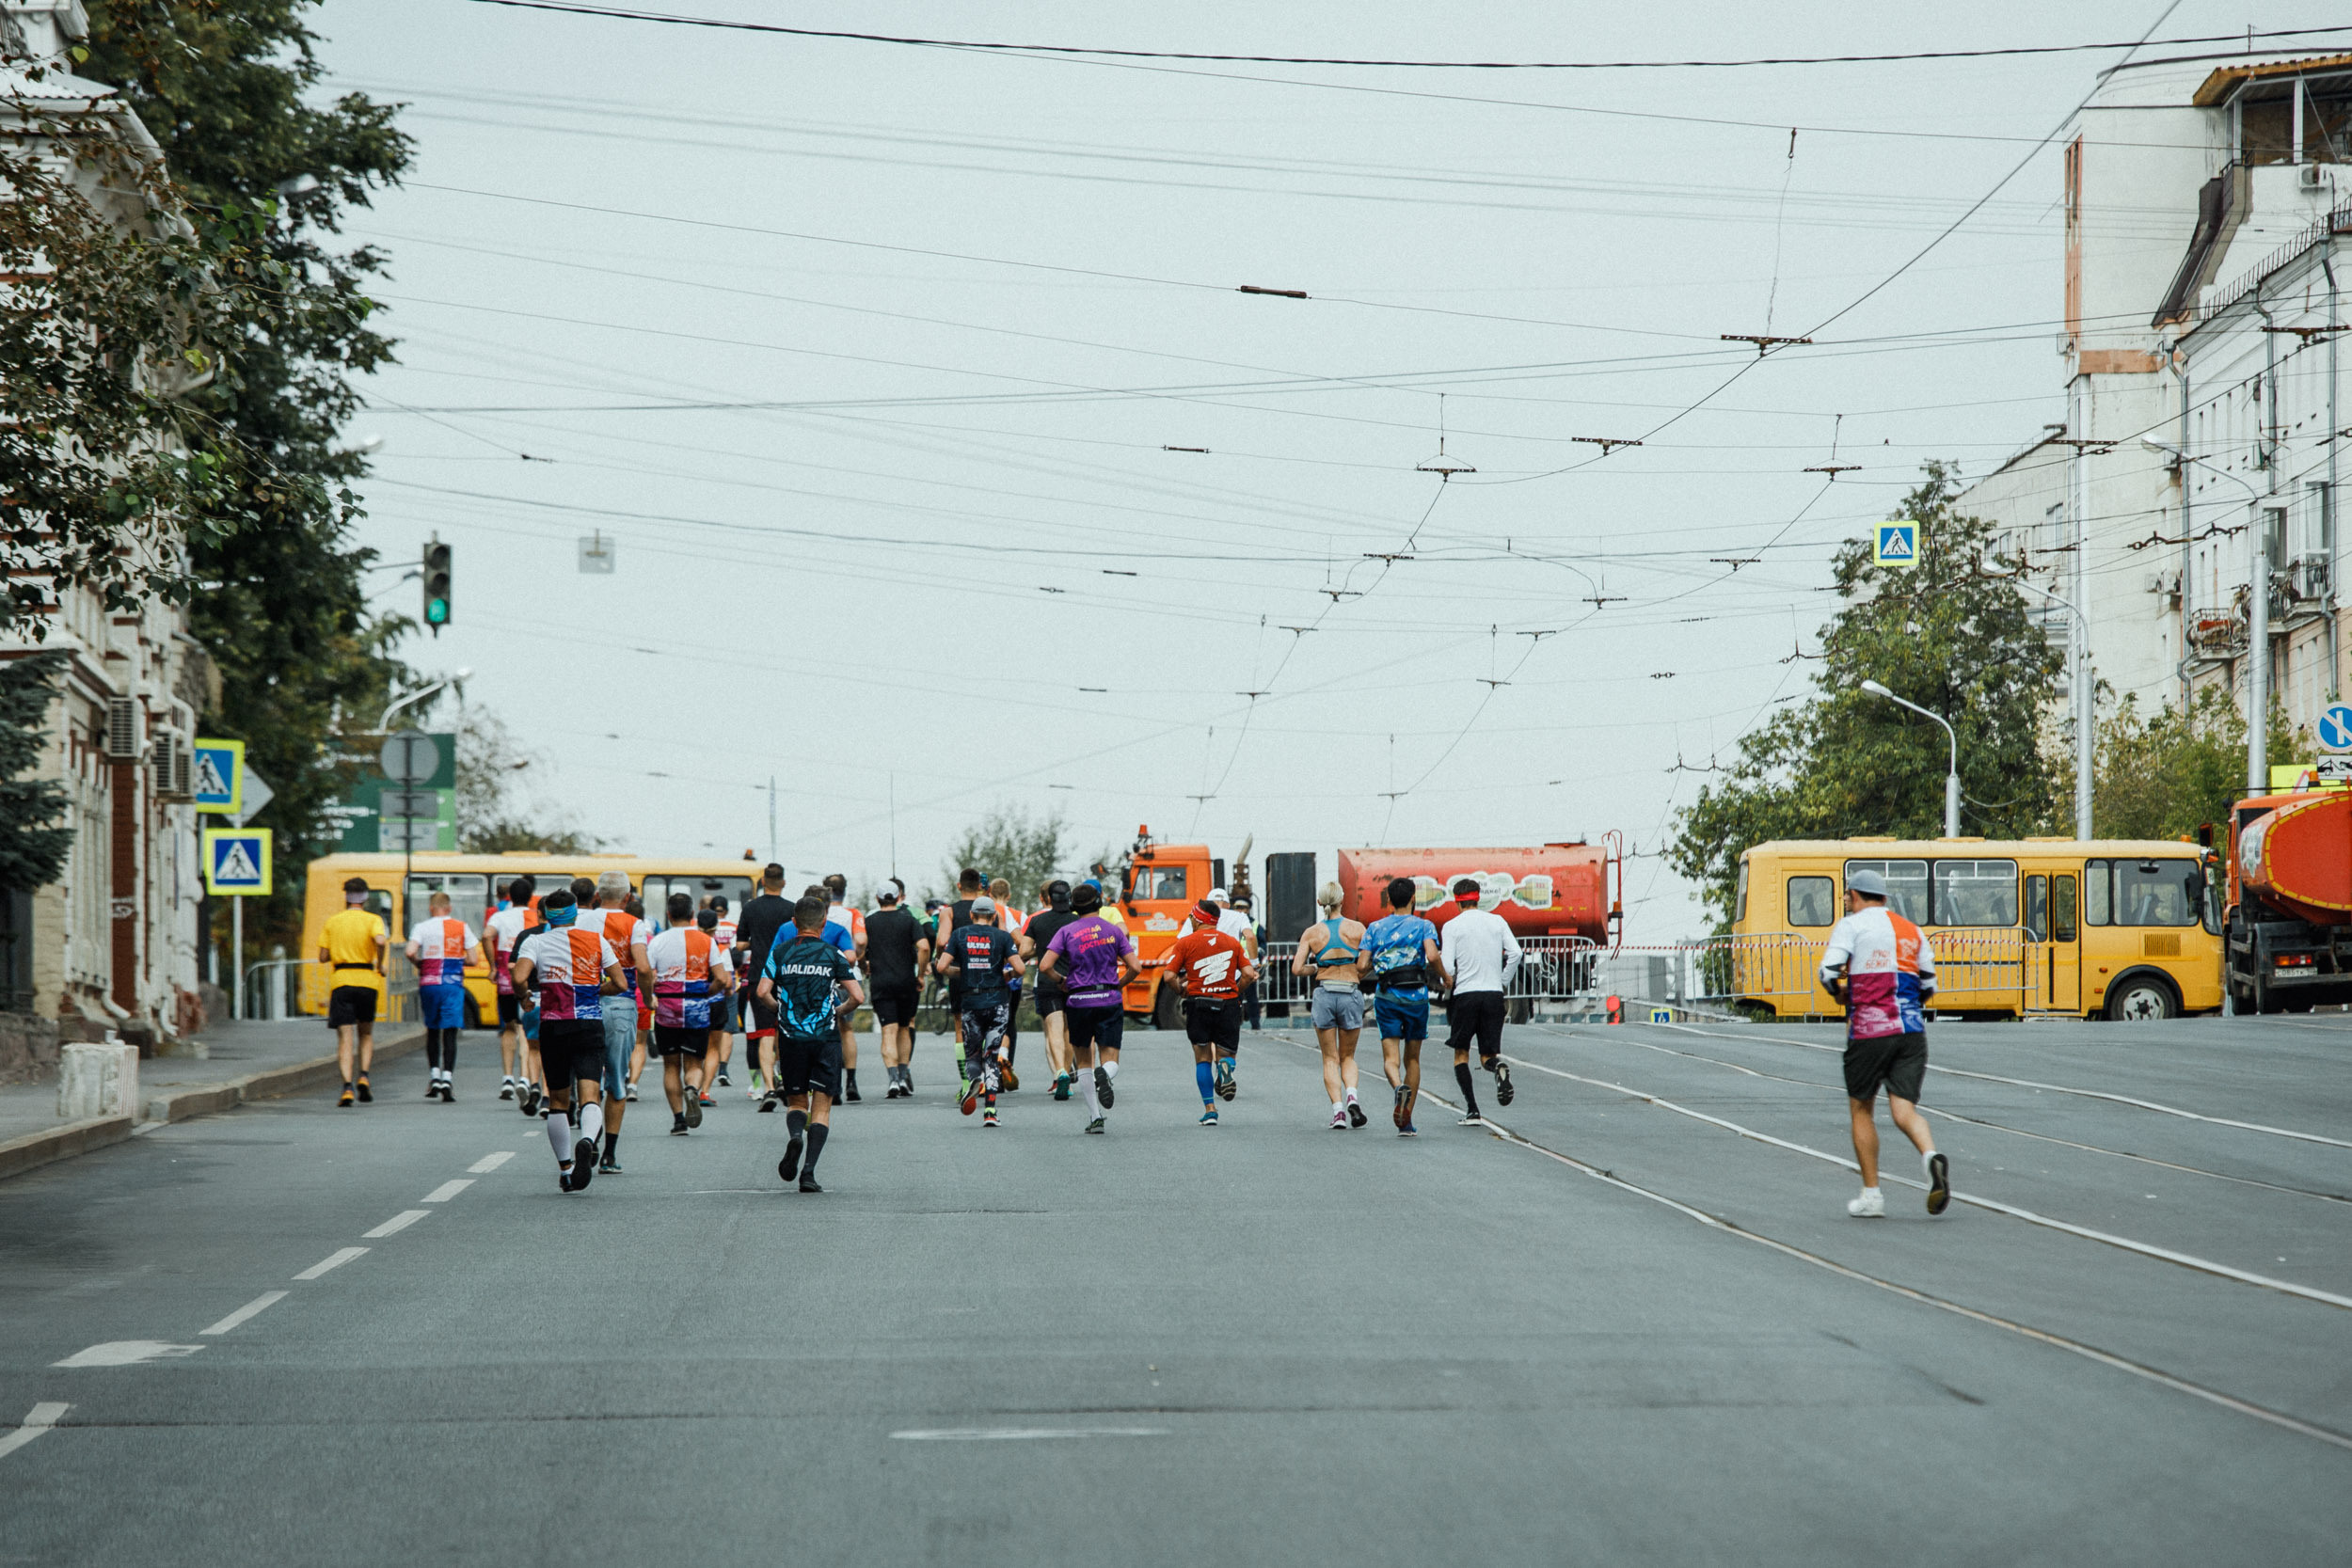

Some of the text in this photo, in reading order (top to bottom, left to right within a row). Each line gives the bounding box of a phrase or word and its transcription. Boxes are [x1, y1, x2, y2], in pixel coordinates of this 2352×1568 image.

[966, 935, 991, 943] URAL
[966, 942, 991, 950] ULTRA
[781, 963, 833, 977] MALIDAK
